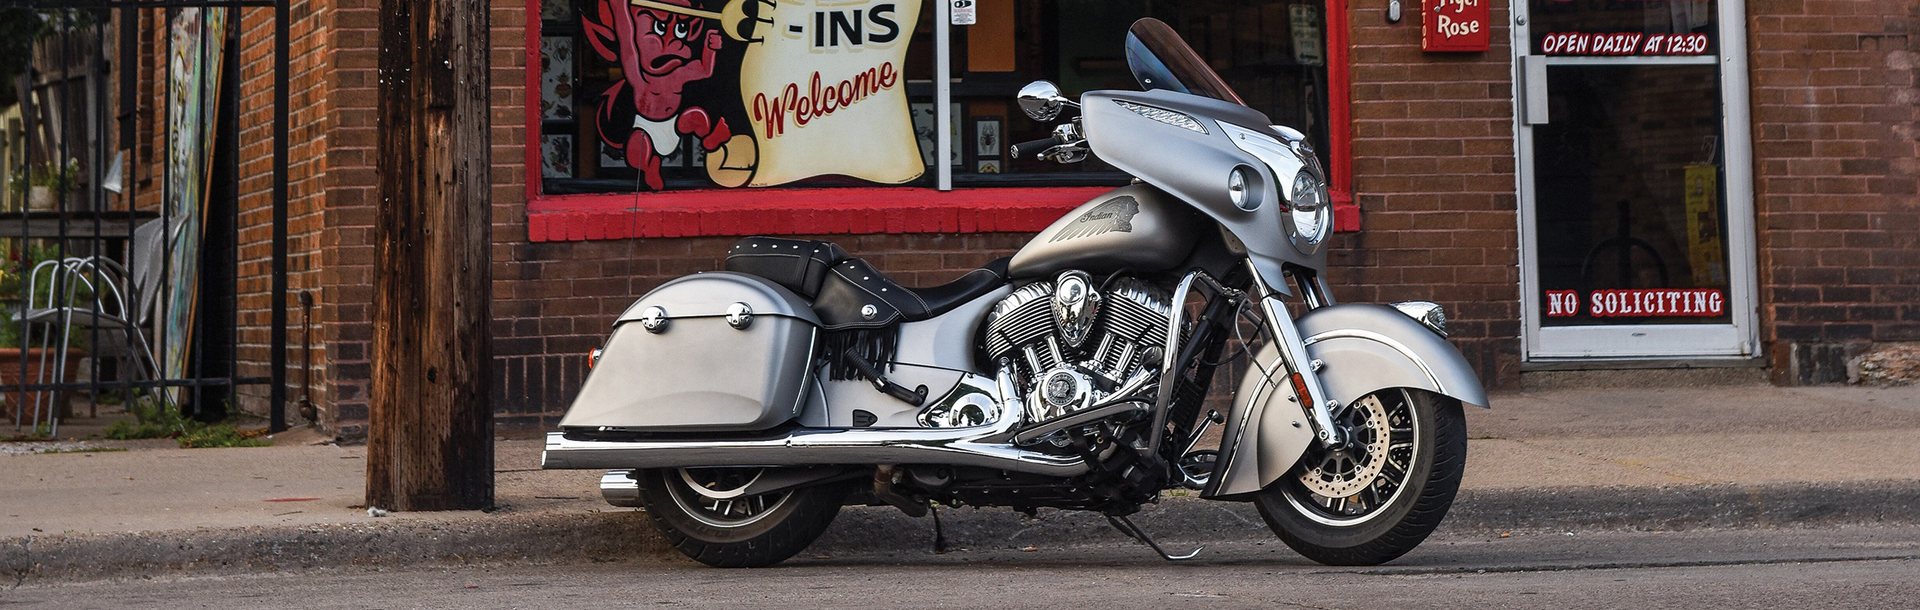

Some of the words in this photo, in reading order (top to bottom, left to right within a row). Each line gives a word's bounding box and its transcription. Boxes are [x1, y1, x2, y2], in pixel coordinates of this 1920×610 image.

[1437, 15, 1480, 39] Rose
[1543, 34, 1589, 53] OPEN
[1593, 34, 1641, 53] DAILY
[1644, 35, 1664, 52] AT
[1666, 35, 1707, 53] 12:30
[753, 61, 898, 140] Welcome
[1080, 211, 1113, 223] Indian
[1549, 292, 1577, 314] NO
[1592, 291, 1722, 313] SOLICITING
